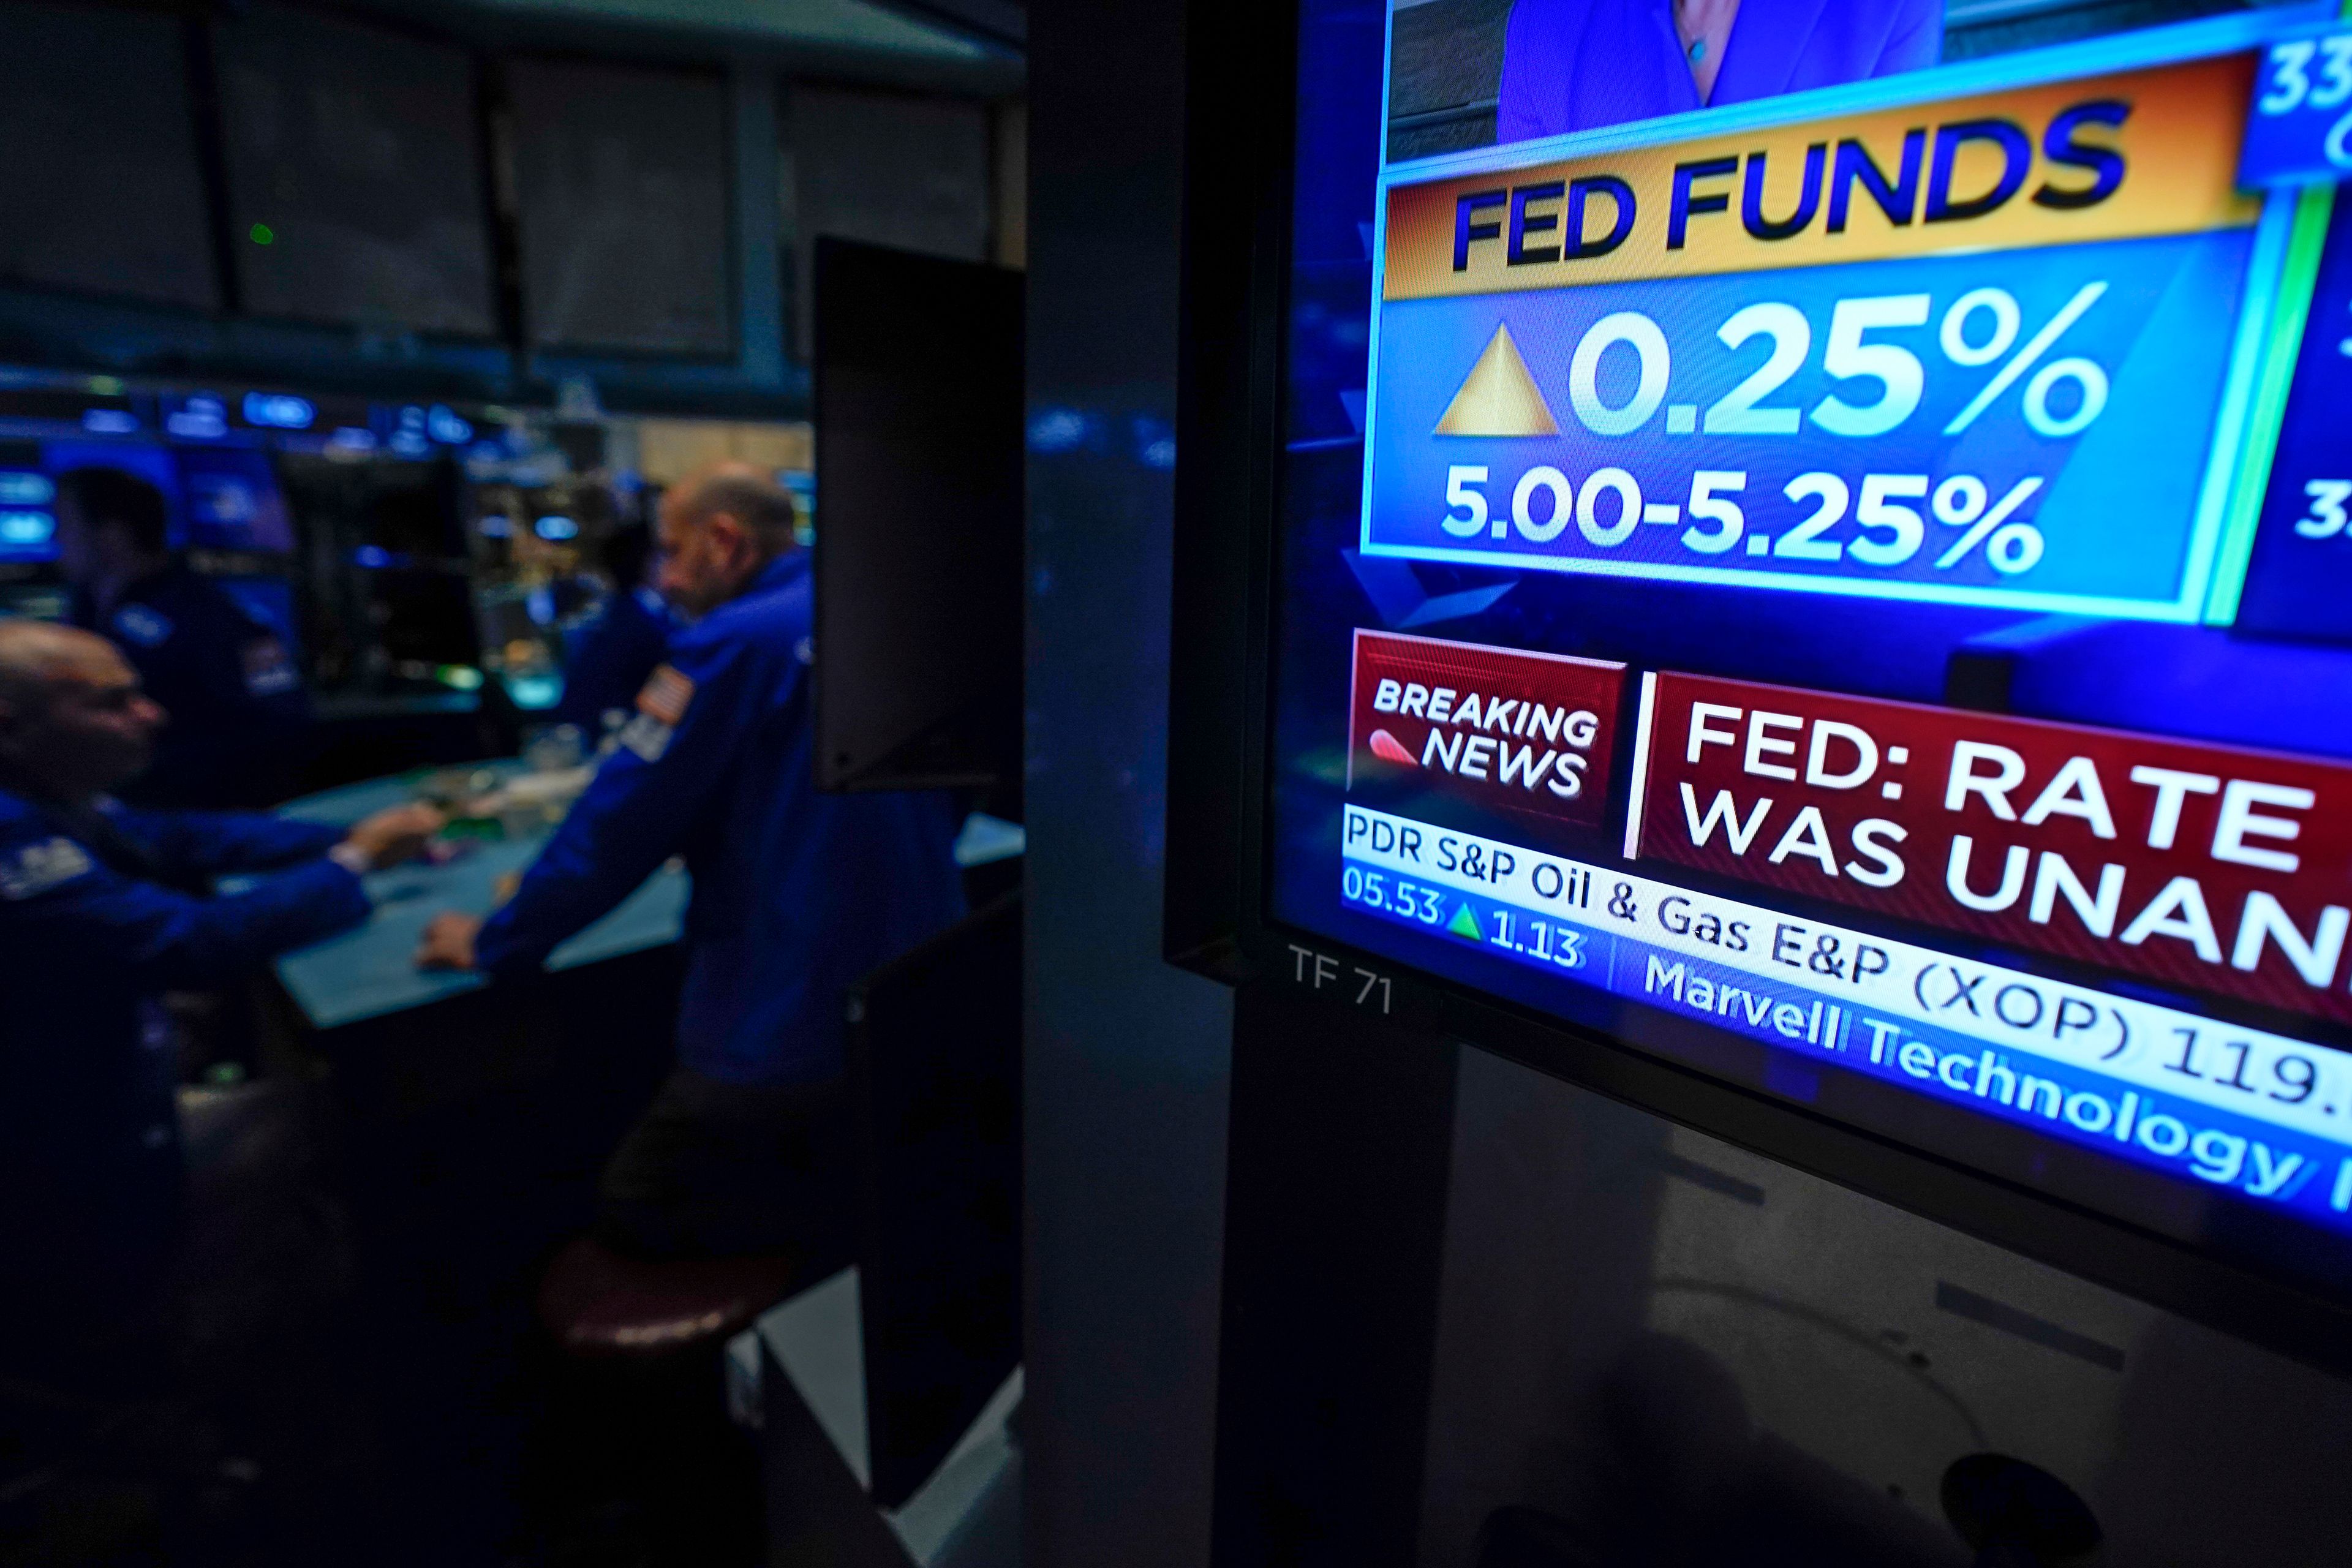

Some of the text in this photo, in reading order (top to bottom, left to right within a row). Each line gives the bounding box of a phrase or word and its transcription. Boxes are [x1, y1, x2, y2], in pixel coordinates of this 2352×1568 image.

[1452, 98, 2133, 271] FED FUNDS
[1569, 281, 2109, 437] 0.25%
[1441, 464, 2044, 575] 5.00-5.25%
[1373, 678, 1599, 747] BREAKING
[1422, 728, 1588, 800] NEWS
[1687, 701, 2315, 873] FED: RATE
[1343, 867, 1580, 968] 05.53 1.13
[1348, 813, 1422, 863] PDR
[1437, 836, 1516, 884] S&P
[1531, 862, 1592, 908] Oil
[1607, 882, 1637, 922] &
[1658, 895, 1751, 952] Gas
[1772, 922, 1890, 984] E&P
[1913, 962, 2129, 1061] (XOP)
[1679, 782, 2352, 993] WAS UNAN
[1289, 944, 1392, 1014] TF 71
[1645, 954, 1840, 1049] Marvell
[1863, 1017, 2304, 1197] Technology
